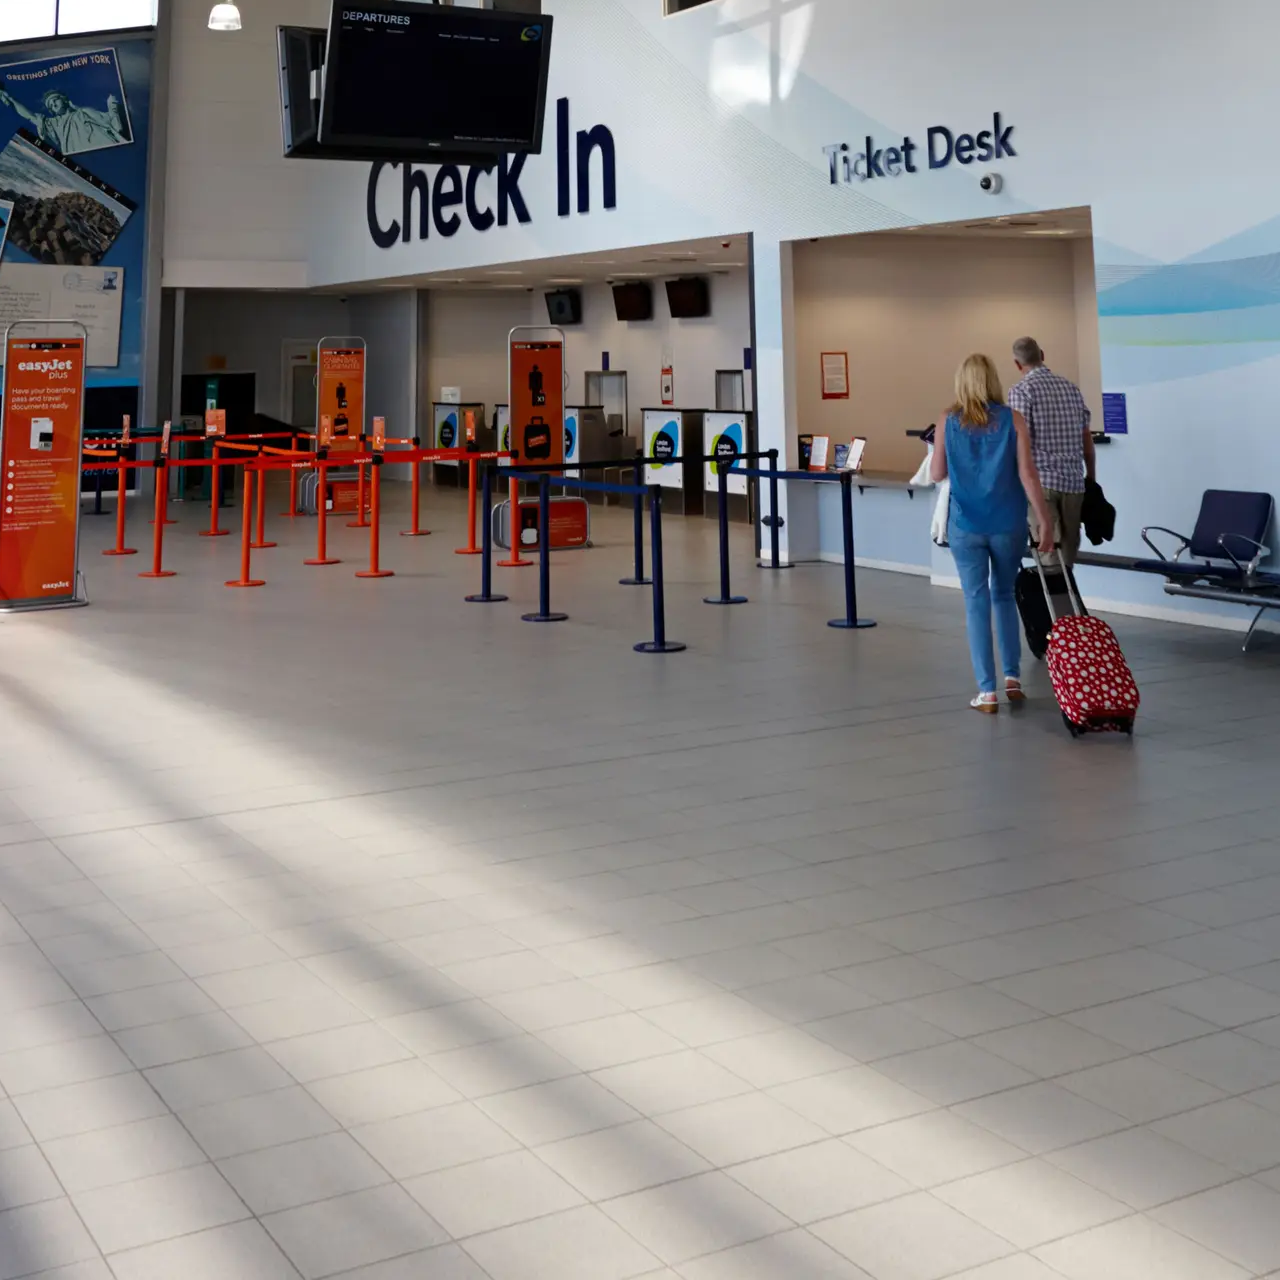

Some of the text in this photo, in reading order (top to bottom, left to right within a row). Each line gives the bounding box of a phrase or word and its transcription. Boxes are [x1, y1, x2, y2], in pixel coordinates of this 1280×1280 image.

[342, 10, 411, 25] DEPARTURES
[6, 54, 111, 81] GREETINGS FROM NEW YORK
[822, 111, 1018, 185] Ticket Desk
[34, 138, 121, 200] BELFAST
[367, 97, 617, 249] Check In
[18, 359, 73, 373] easyJet
[49, 371, 68, 380] plus
[12, 387, 29, 395] Have
[46, 386, 76, 394] boarding
[11, 401, 69, 410] documents ready
[12, 395, 27, 403] pass
[43, 394, 61, 402] travel
[42, 580, 69, 590] easyJet
